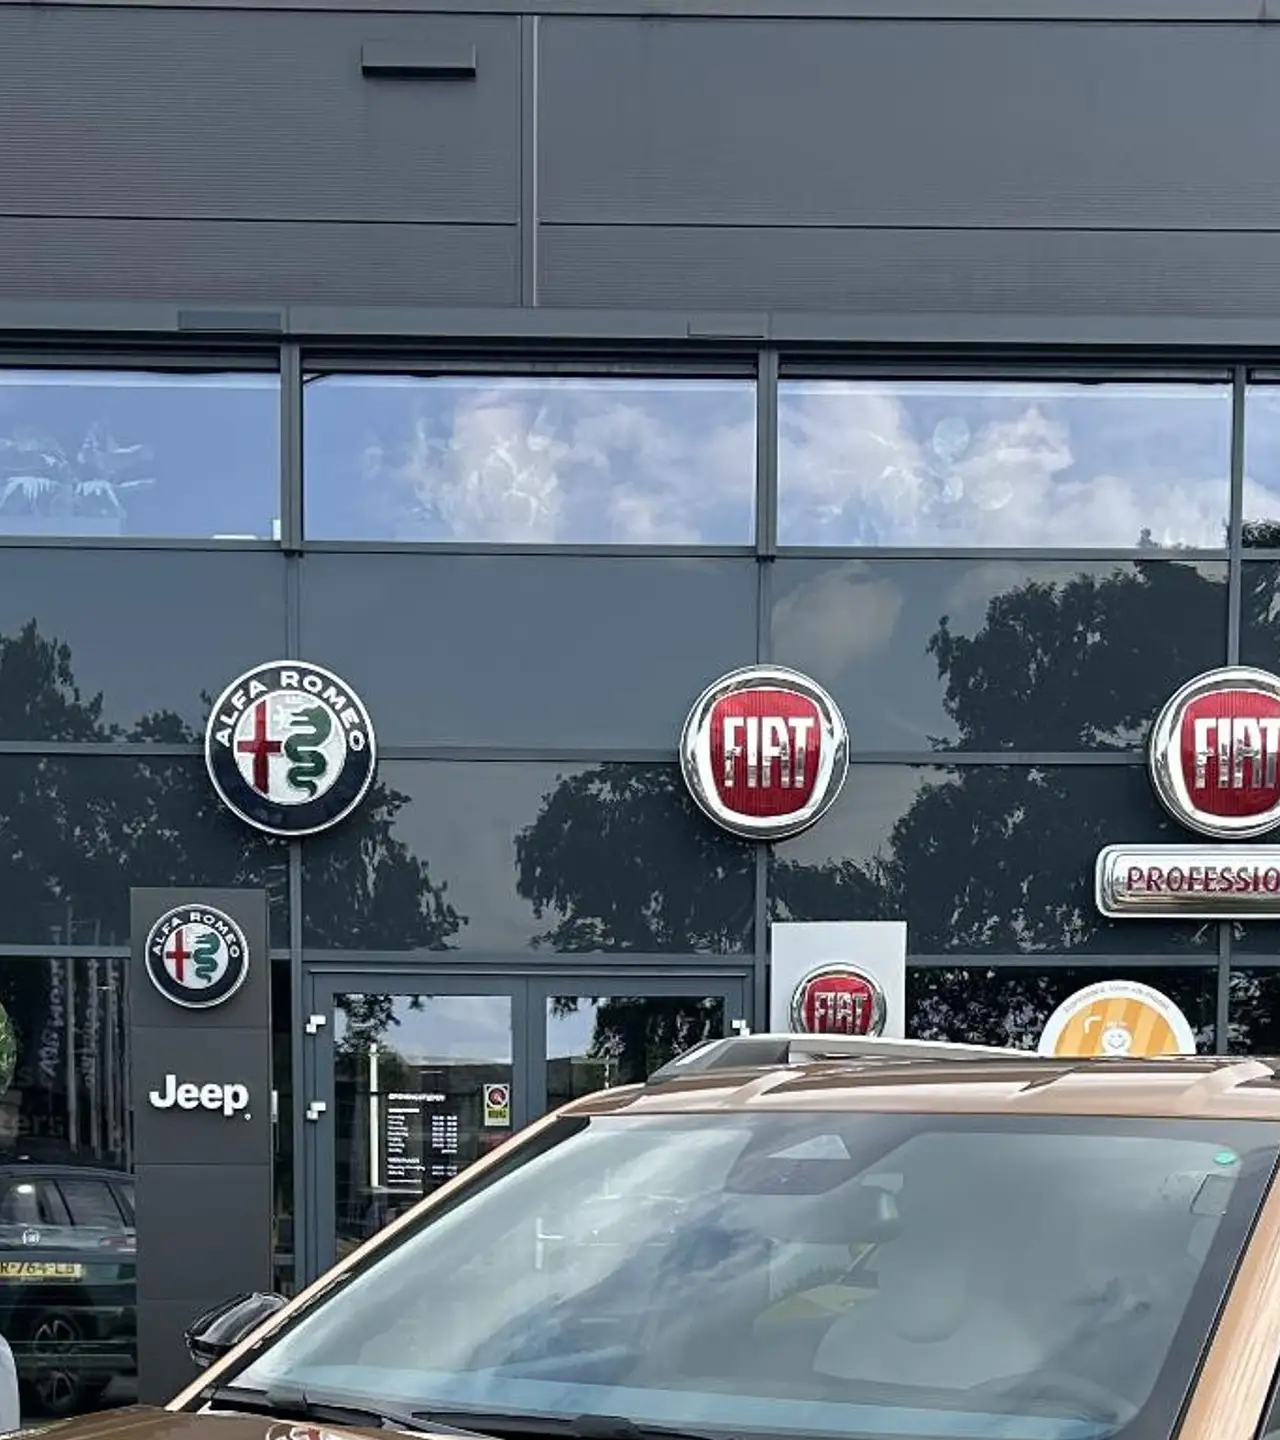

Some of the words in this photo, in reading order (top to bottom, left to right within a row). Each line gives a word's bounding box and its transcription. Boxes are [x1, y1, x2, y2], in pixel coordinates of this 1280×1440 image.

[215, 680, 269, 748] ALFA
[280, 671, 366, 752] ROMEO
[723, 716, 814, 788] FIAT
[152, 917, 184, 957] ALFA
[190, 911, 241, 958] ROMEO
[814, 992, 869, 1035] FIAT
[149, 1074, 250, 1117] Jeep
